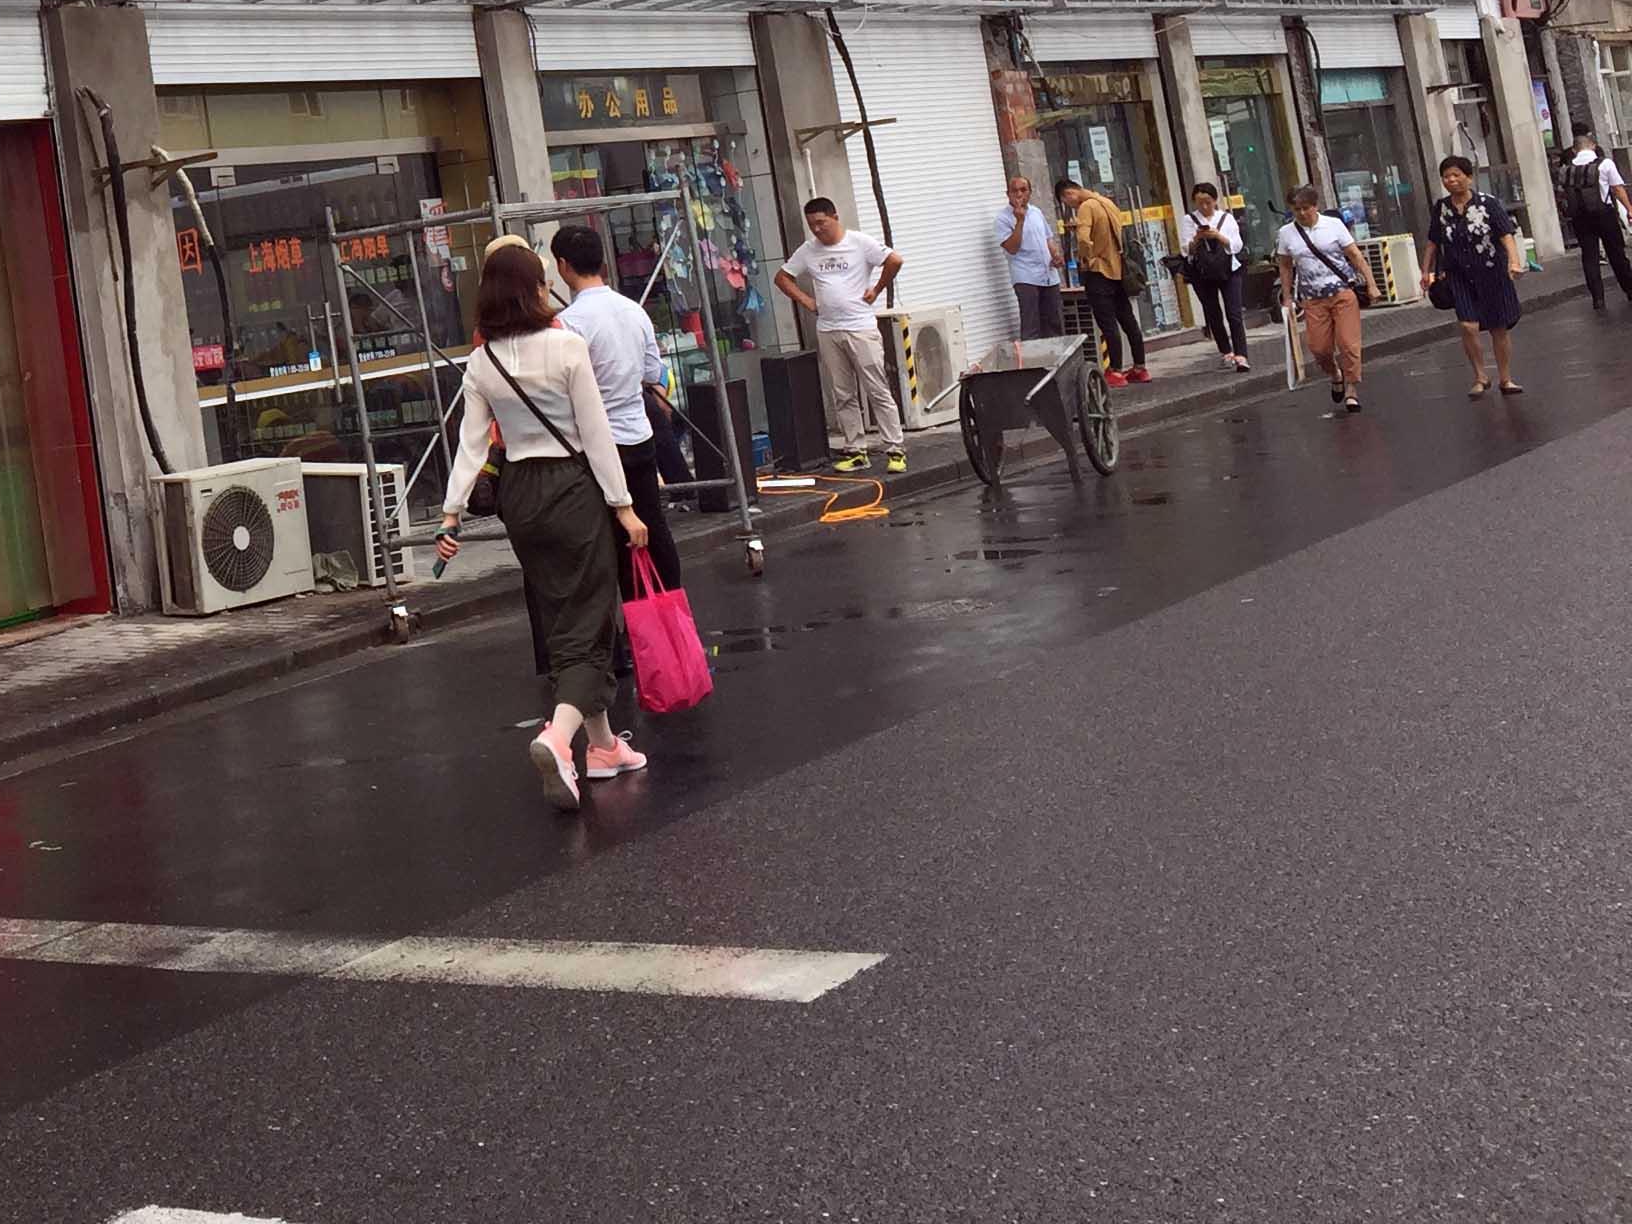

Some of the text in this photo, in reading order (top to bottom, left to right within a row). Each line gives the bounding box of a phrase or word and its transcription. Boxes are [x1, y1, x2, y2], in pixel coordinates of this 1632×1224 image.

[577, 87, 679, 118] 办公用品
[248, 236, 304, 273] 上海烟草
